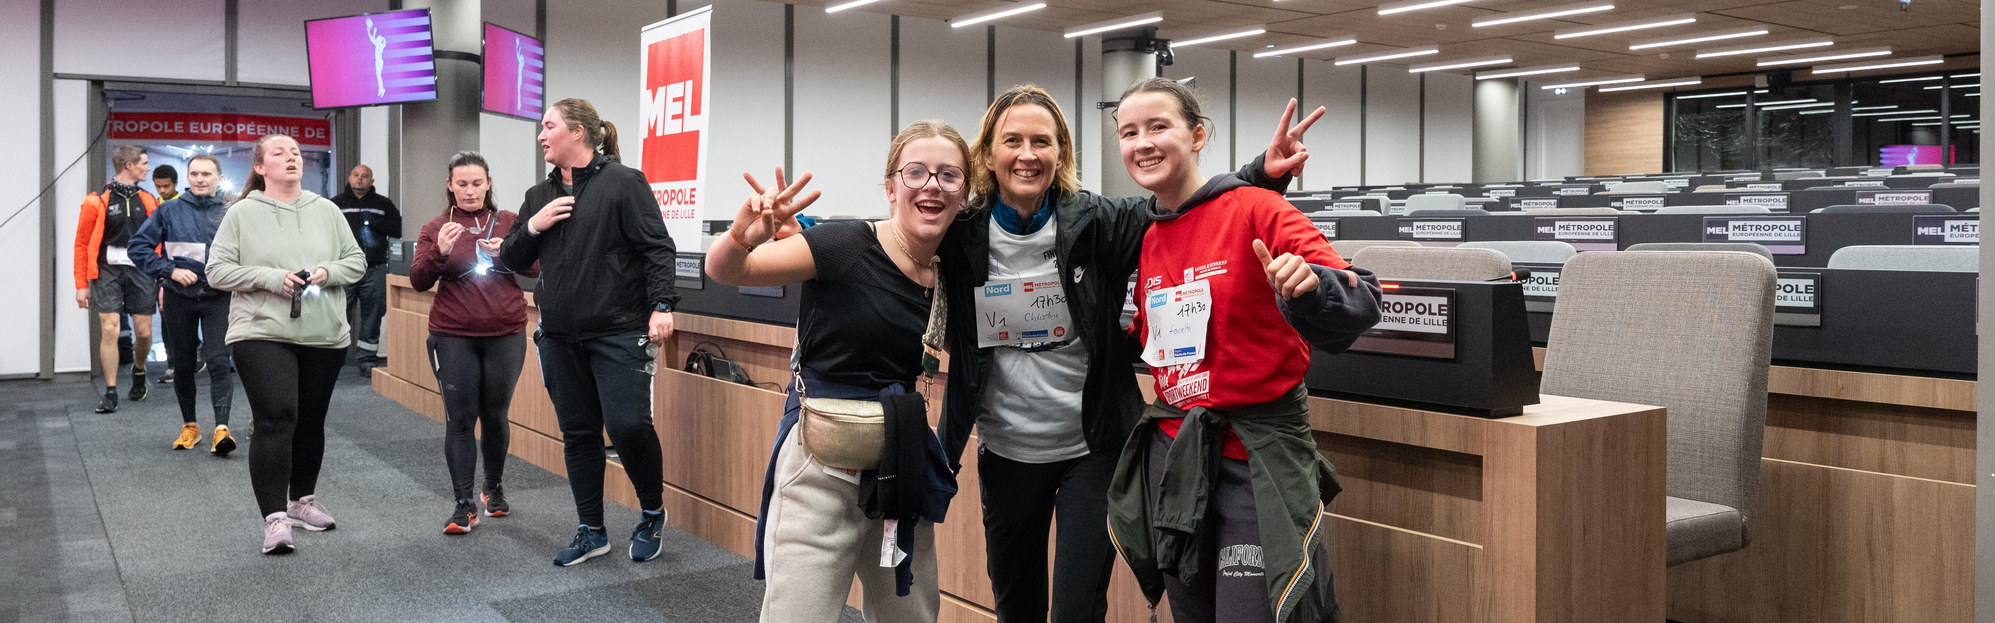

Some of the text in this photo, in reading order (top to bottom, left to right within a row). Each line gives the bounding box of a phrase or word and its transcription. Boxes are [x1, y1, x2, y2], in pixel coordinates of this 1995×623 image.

[643, 79, 702, 139] MEL
[190, 121, 300, 138] EUROPÉENNE
[304, 126, 326, 139] DE
[680, 209, 696, 219] LILLE
[1558, 222, 1614, 231] MÉTROPOLE
[1706, 226, 1729, 234] MEL
[1732, 222, 1801, 232] MÉTROPOLE
[1917, 226, 1946, 236] MEL
[986, 285, 1010, 294] Nord
[1030, 294, 1067, 308] 17h30
[1151, 293, 1166, 304] Nord
[1177, 302, 1206, 318] 17h30
[1424, 318, 1448, 326] LILLE
